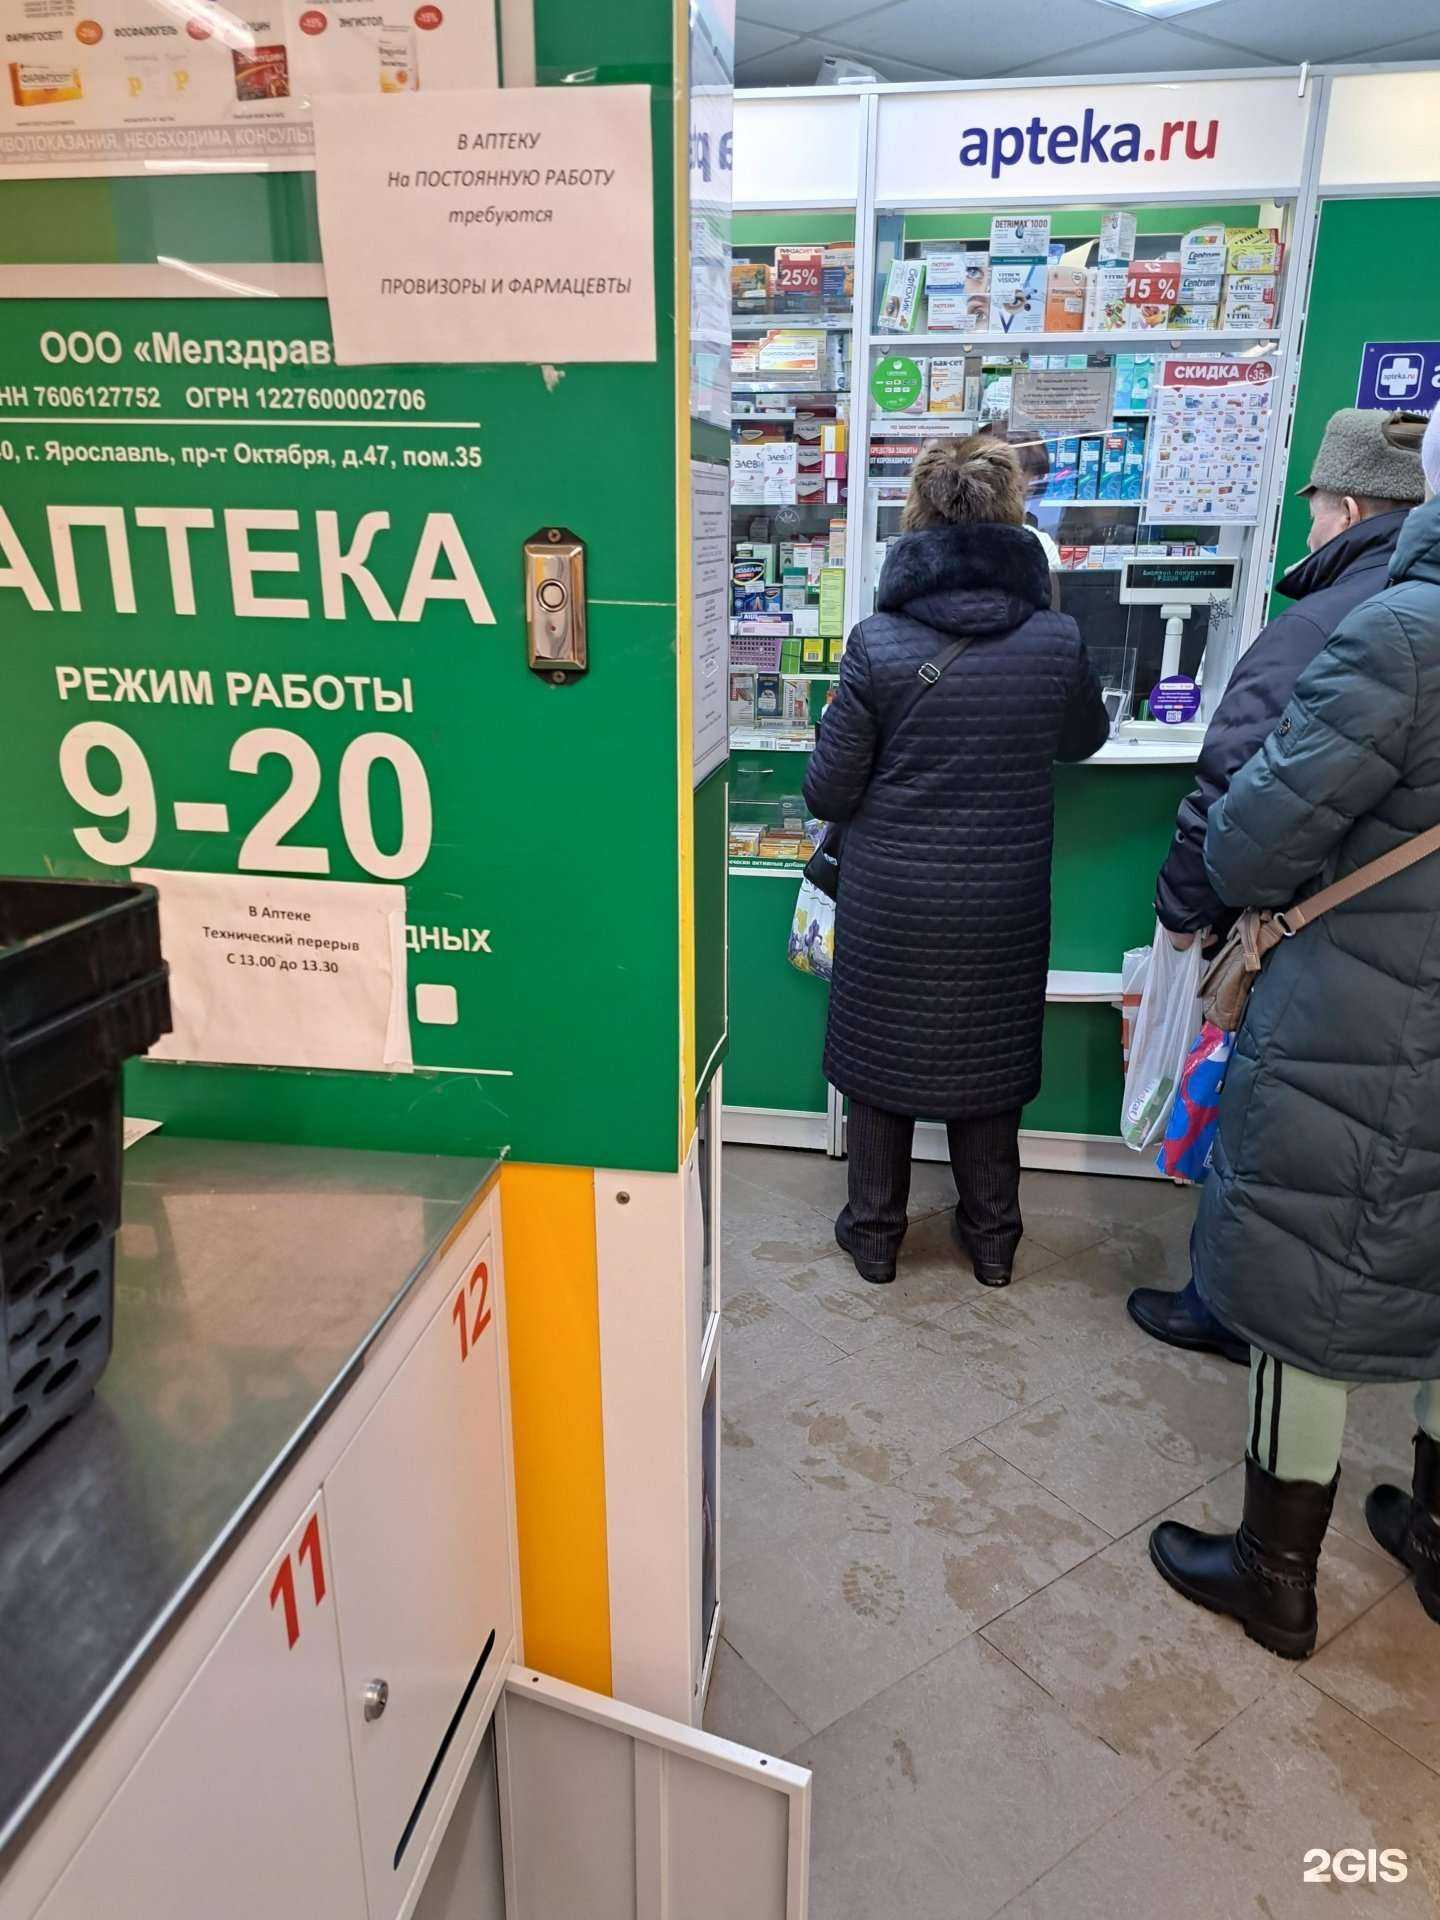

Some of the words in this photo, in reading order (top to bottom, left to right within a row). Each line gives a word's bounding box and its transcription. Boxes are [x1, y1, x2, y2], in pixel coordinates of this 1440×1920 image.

[0, 132, 119, 152] ВОПОКАЗАНИЯ.
[236, 126, 313, 146] КОНСУЛЬТ
[457, 134, 468, 150] В
[473, 132, 541, 150] АПТЕКУ
[959, 108, 1219, 179] apteka.ru
[388, 172, 410, 188] На
[415, 169, 540, 187] ПОСТОЯННУЮ
[545, 168, 614, 186] РАБОТУ
[449, 206, 553, 226] требуются
[1031, 219, 1047, 228] 1000
[381, 278, 486, 295] ПРОВИЗОРЫ
[491, 278, 504, 294] И
[509, 277, 631, 299] ФАРМАЦЕВТЫ
[782, 268, 818, 286] 25%
[1183, 280, 1216, 288] Centrum
[1127, 279, 1151, 299] 15
[1158, 279, 1175, 300] %
[40, 331, 122, 364] ООО
[133, 331, 331, 371] «Мелздрав
[1174, 365, 1239, 380] СКИДКА
[0, 386, 29, 407] НН
[33, 386, 161, 409] 7606127752
[186, 387, 249, 409] ОГРН
[256, 388, 426, 411] 1227600002706
[0, 440, 20, 464] 0,
[25, 445, 39, 461] г.
[44, 440, 175, 466] Ярославль,
[182, 445, 227, 467] пр-т
[235, 441, 336, 469] Октября,
[342, 445, 396, 469] д.47,
[403, 446, 482, 467] пом.35
[55, 665, 214, 706] РЕЖИМ
[226, 672, 414, 713] РАБОТЫ
[59, 721, 433, 880] 9-20
[248, 905, 258, 917] В
[262, 907, 312, 922] Аптеке
[202, 926, 294, 945] Технический
[297, 937, 360, 952] перерыв
[405, 925, 493, 954] дных
[226, 952, 236, 965] С
[240, 954, 276, 968] 13.00
[279, 960, 298, 972] до
[302, 960, 339, 974] 13.30
[453, 1262, 491, 1362] 12
[270, 1512, 326, 1651] 11
